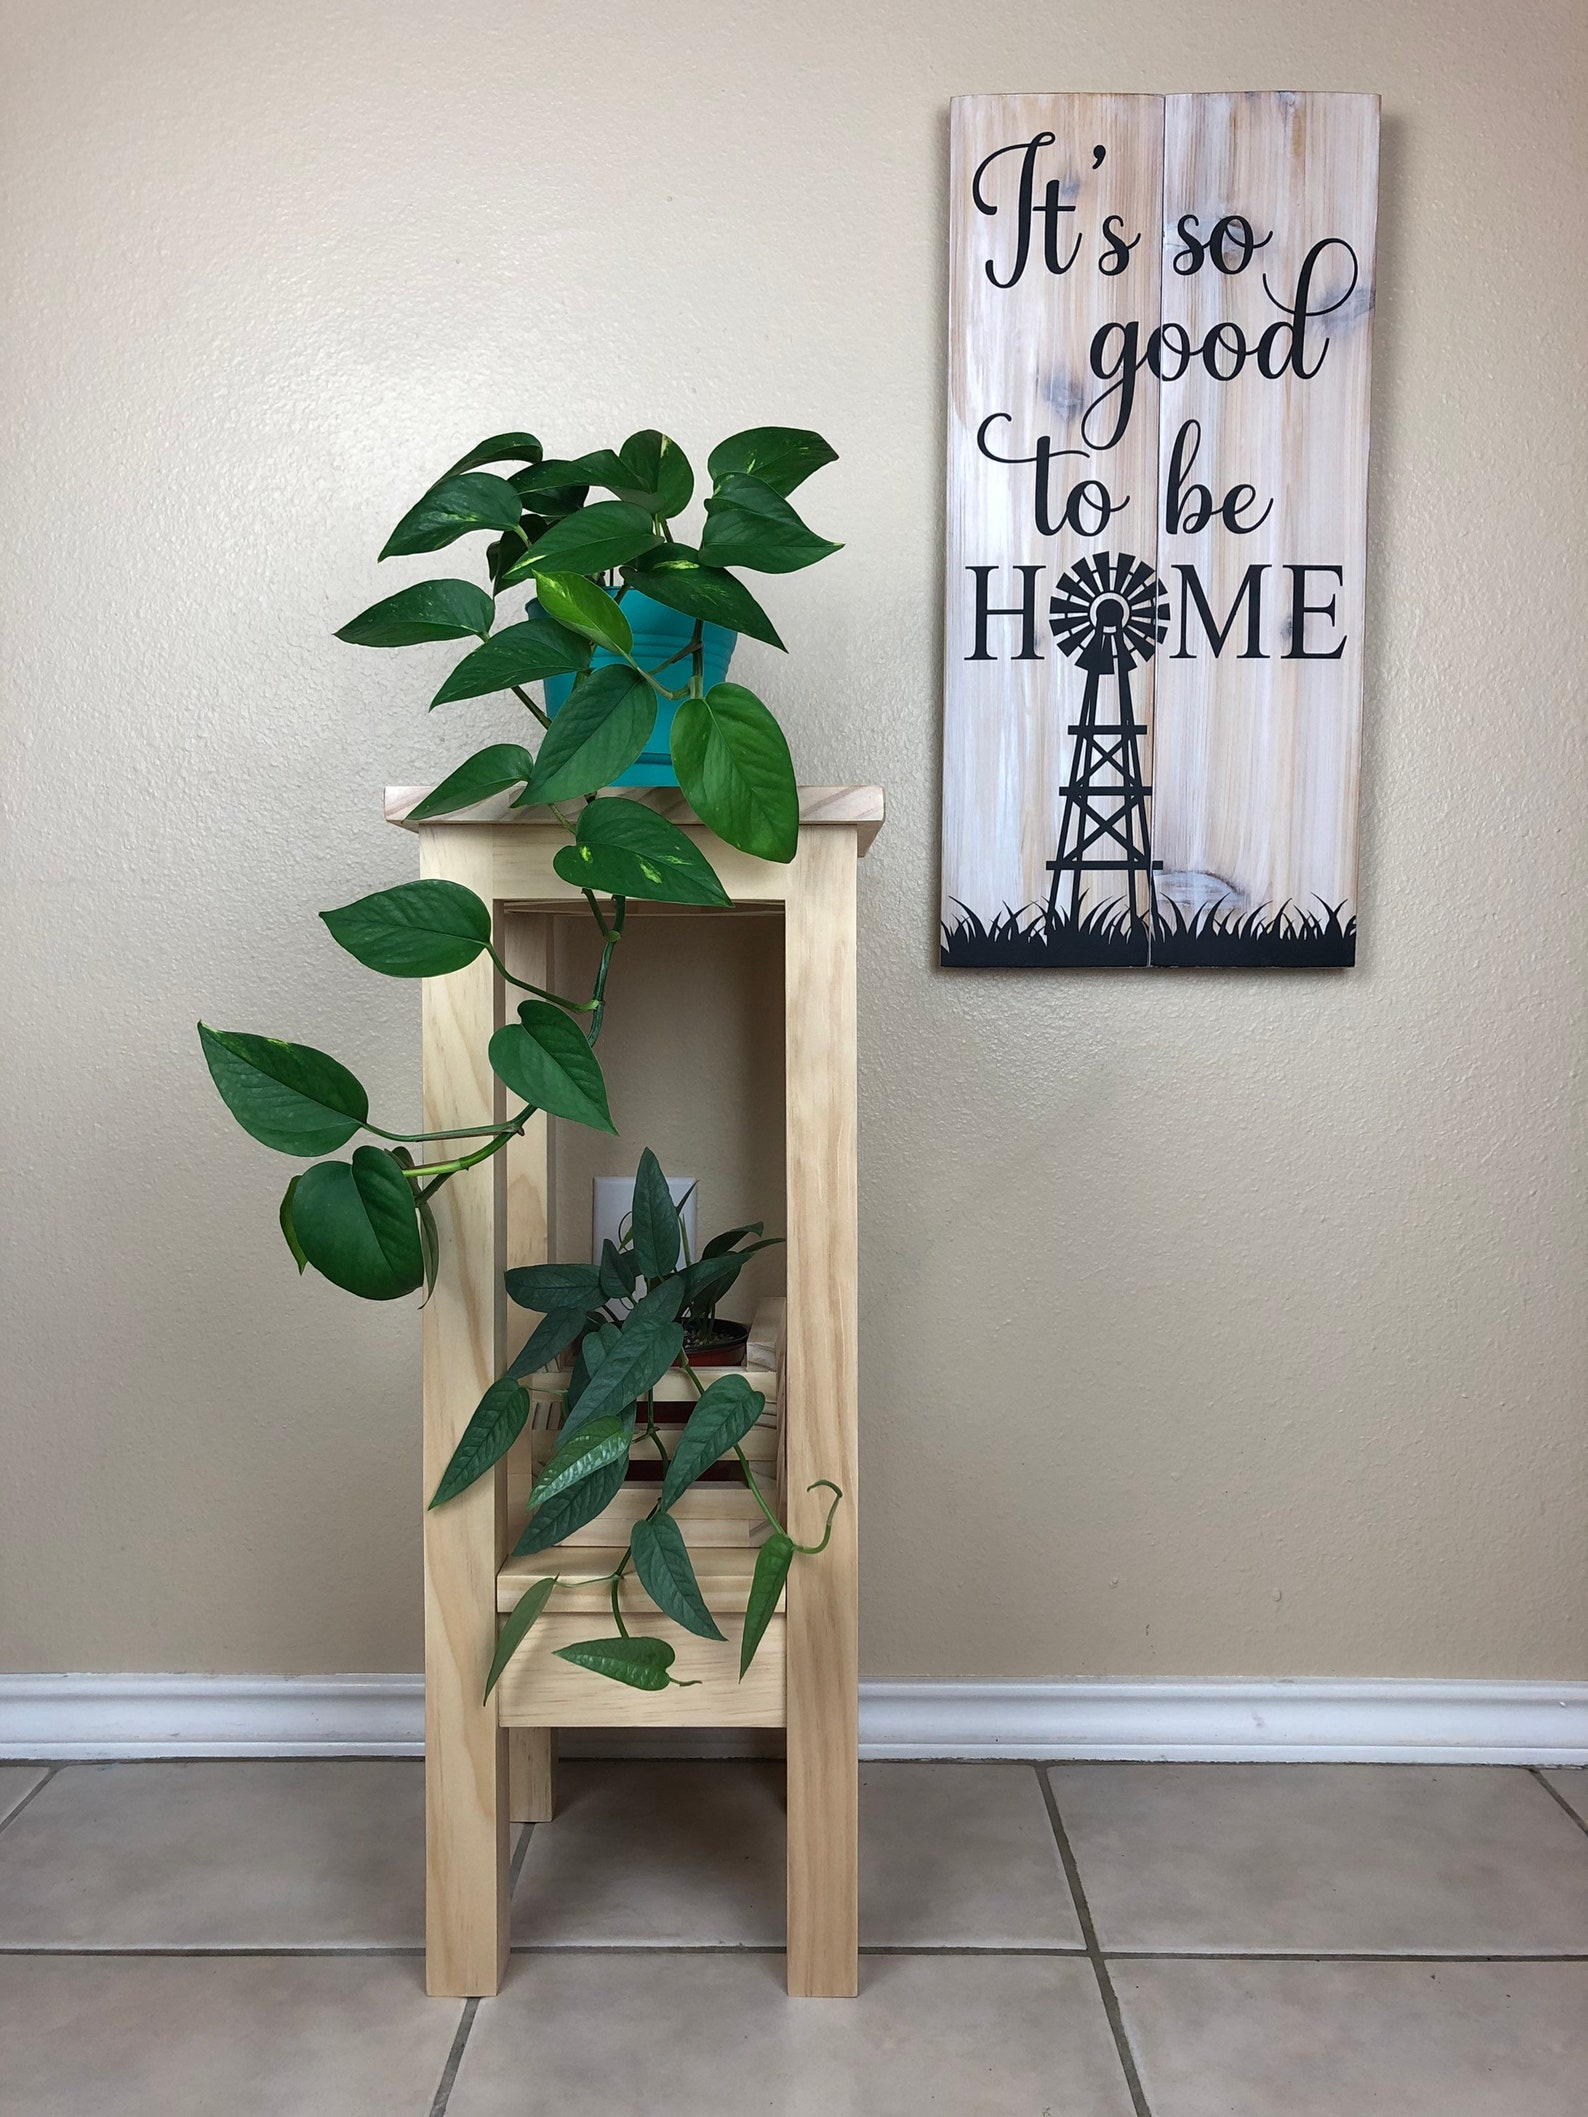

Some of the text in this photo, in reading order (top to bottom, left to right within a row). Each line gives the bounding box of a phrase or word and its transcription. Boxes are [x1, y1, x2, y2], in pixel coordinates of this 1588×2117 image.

[972, 131, 1274, 289] It's so
[1081, 237, 1358, 451] good
[977, 412, 1274, 537] to be
[964, 554, 1348, 661] HOME
